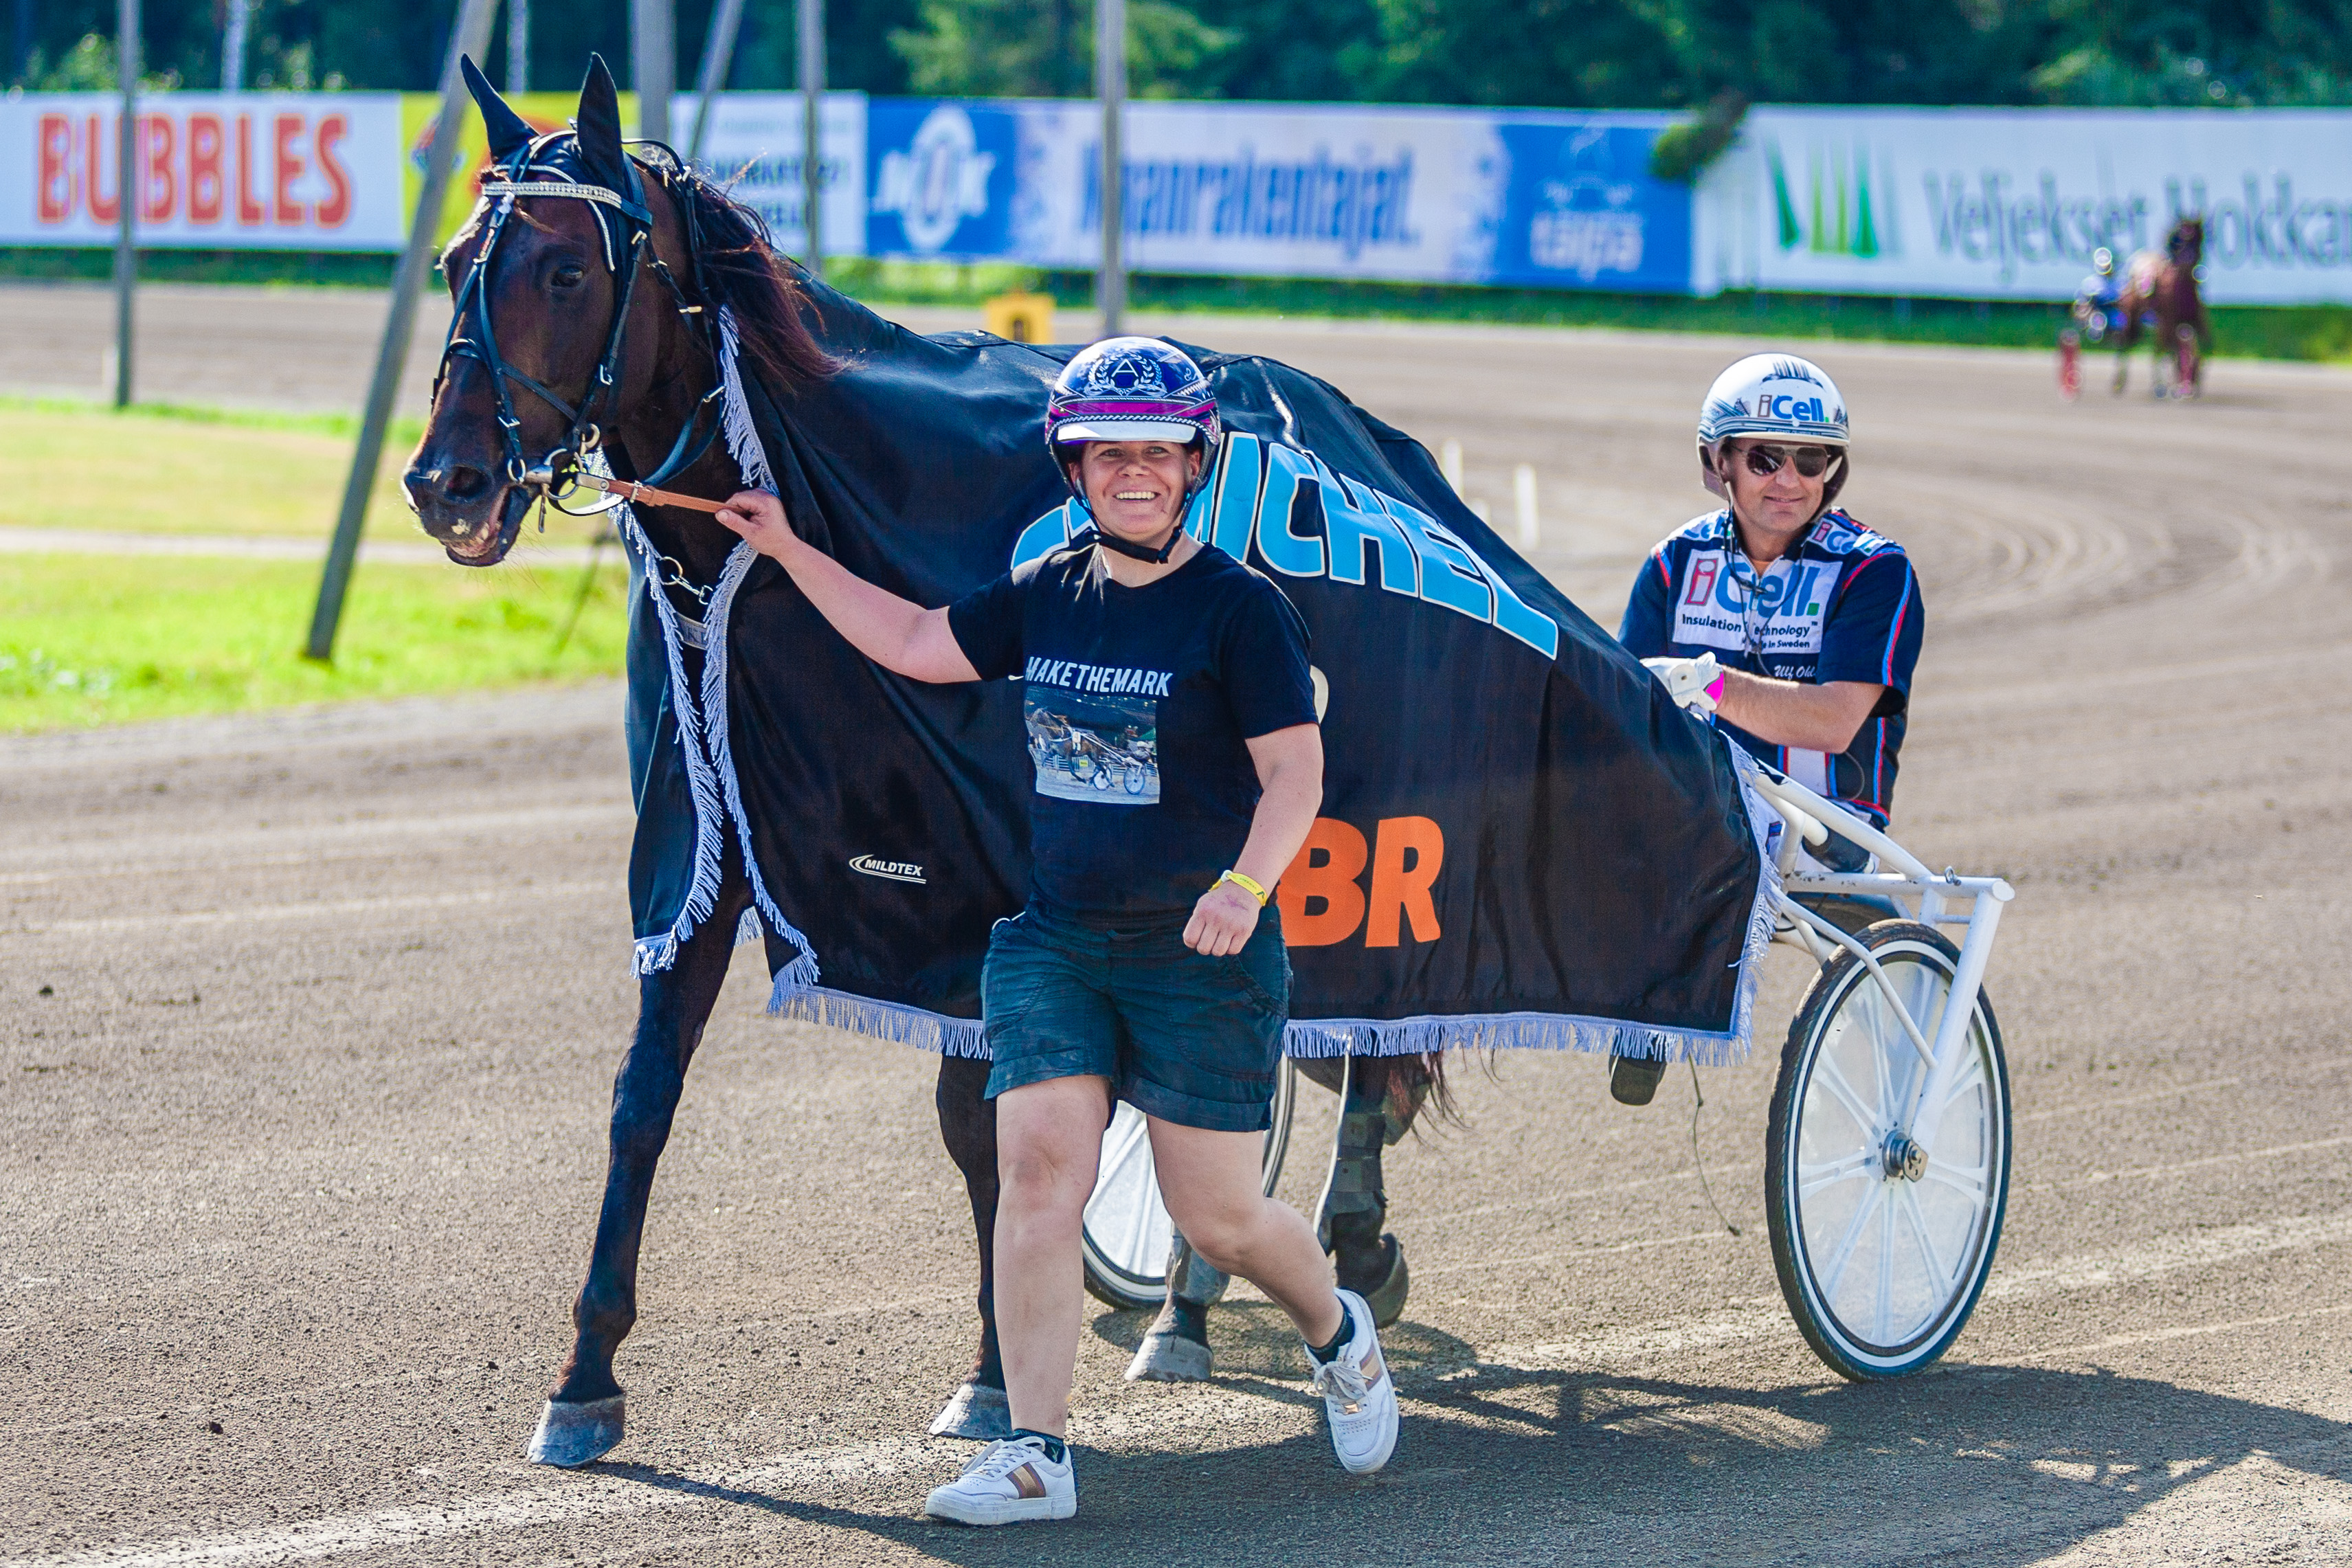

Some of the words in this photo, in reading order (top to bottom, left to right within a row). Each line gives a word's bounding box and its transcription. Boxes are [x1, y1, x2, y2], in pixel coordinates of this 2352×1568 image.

[38, 112, 352, 228] BUBBLES
[1682, 614, 1742, 632] Insulation
[1777, 639, 1810, 648] Sweden
[1024, 656, 1173, 697] MAKETHEMARK
[864, 859, 923, 877] MILDTEX
